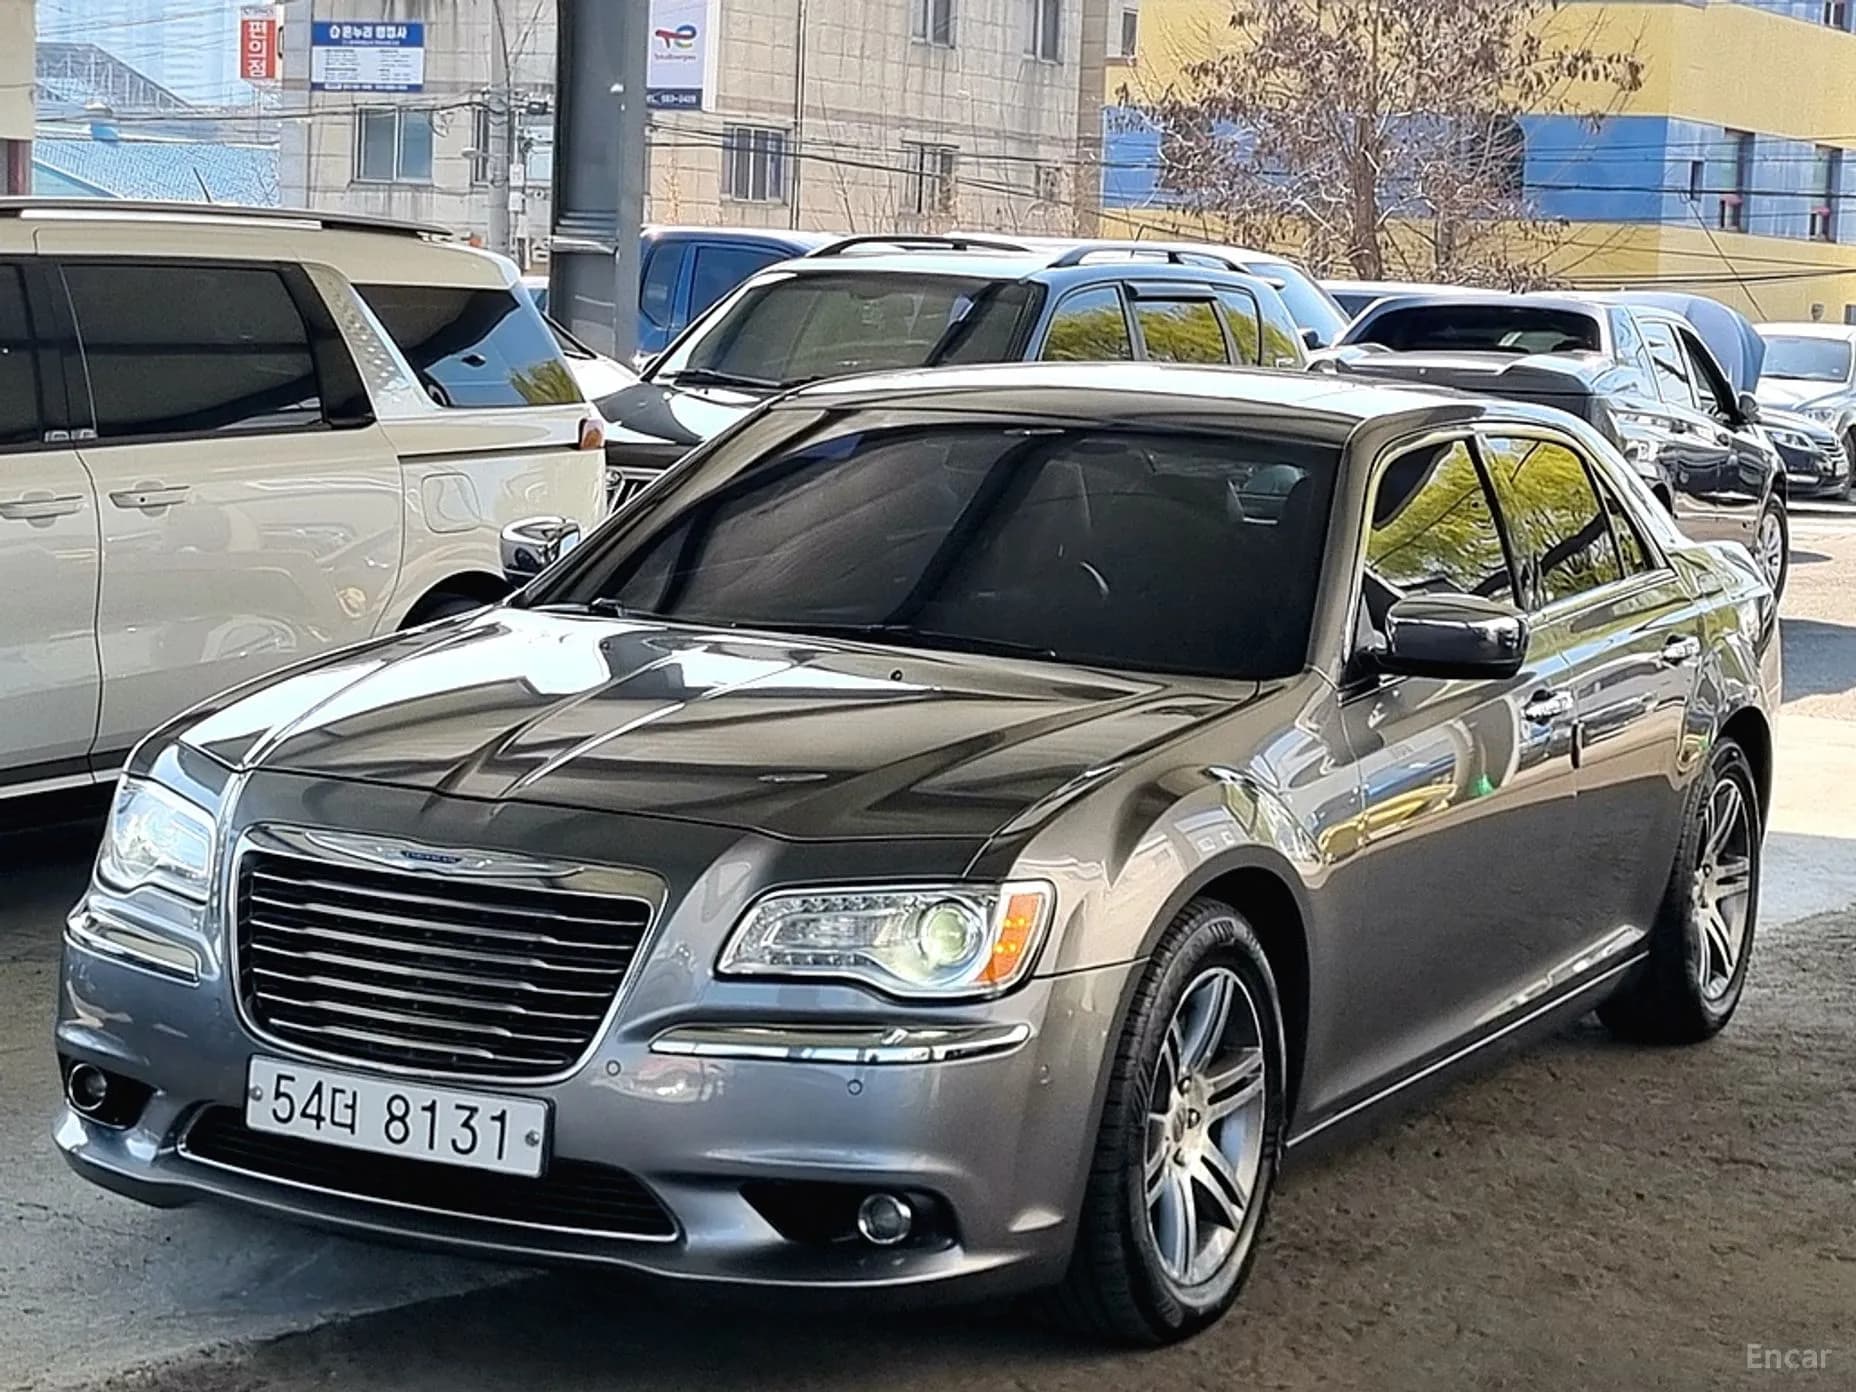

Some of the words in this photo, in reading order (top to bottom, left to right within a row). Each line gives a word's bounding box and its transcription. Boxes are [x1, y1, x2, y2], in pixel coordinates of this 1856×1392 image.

[248, 21, 267, 77] 편의점
[272, 1073, 357, 1136] 54더
[384, 1093, 507, 1161] 8131
